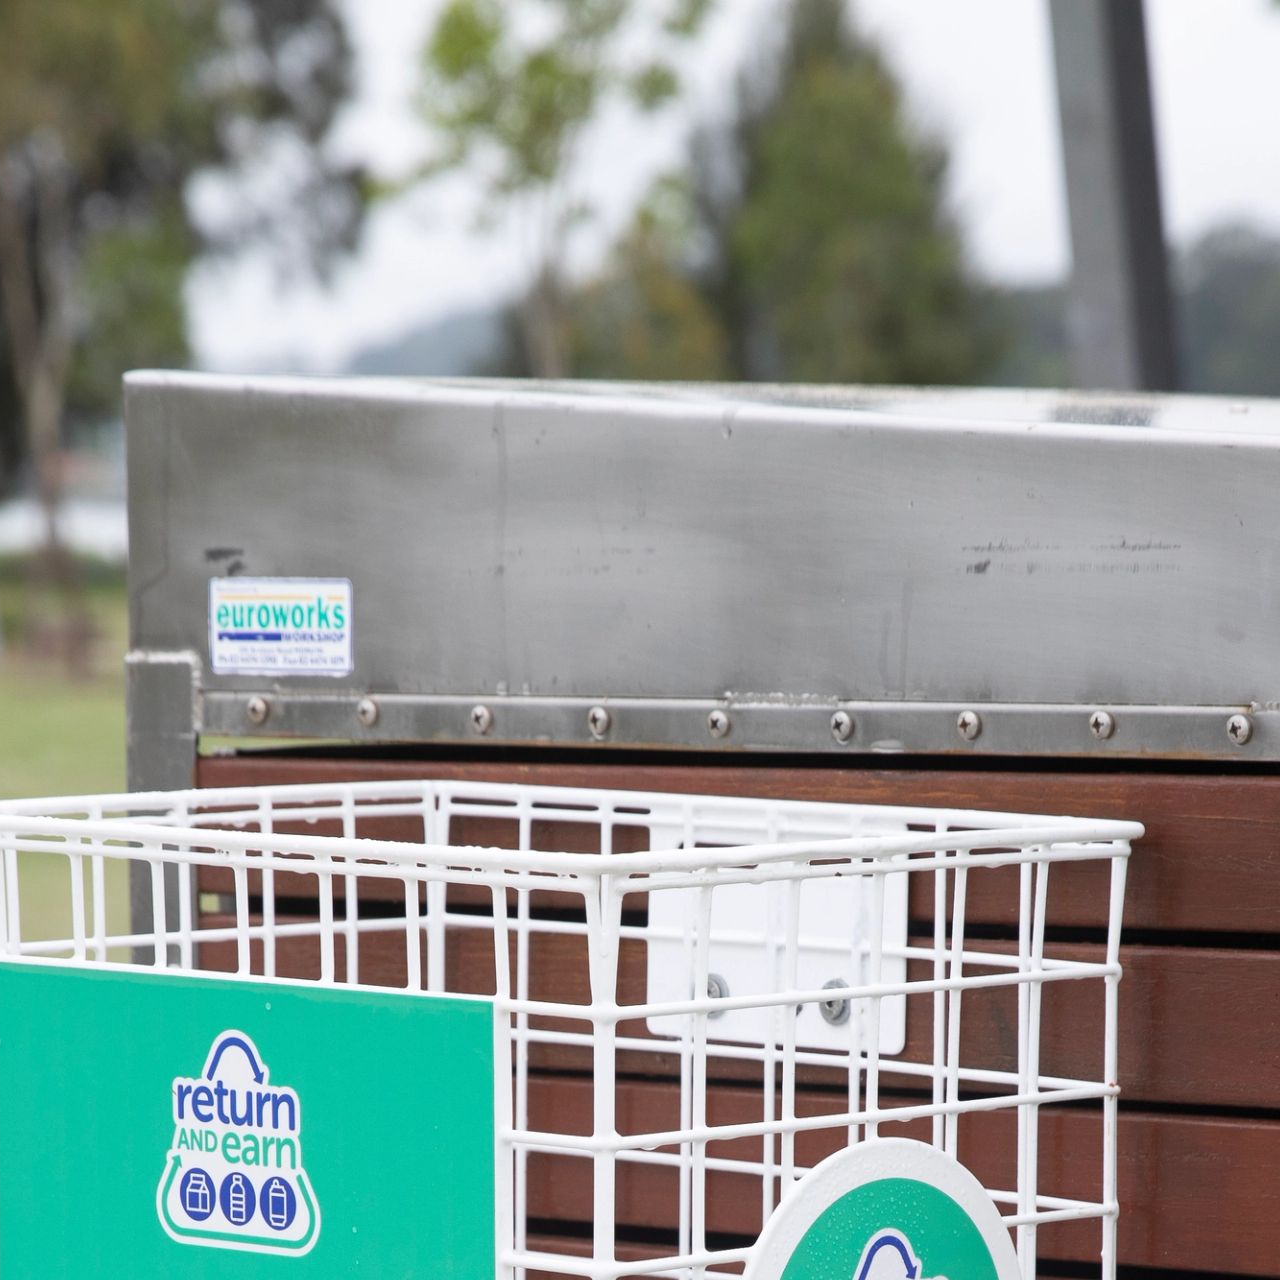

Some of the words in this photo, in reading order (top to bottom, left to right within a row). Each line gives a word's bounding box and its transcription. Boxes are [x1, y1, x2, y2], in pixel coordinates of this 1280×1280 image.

[217, 596, 345, 629] euroworks
[177, 1080, 295, 1131] return
[177, 1127, 218, 1153] AND
[221, 1131, 296, 1170] earn
